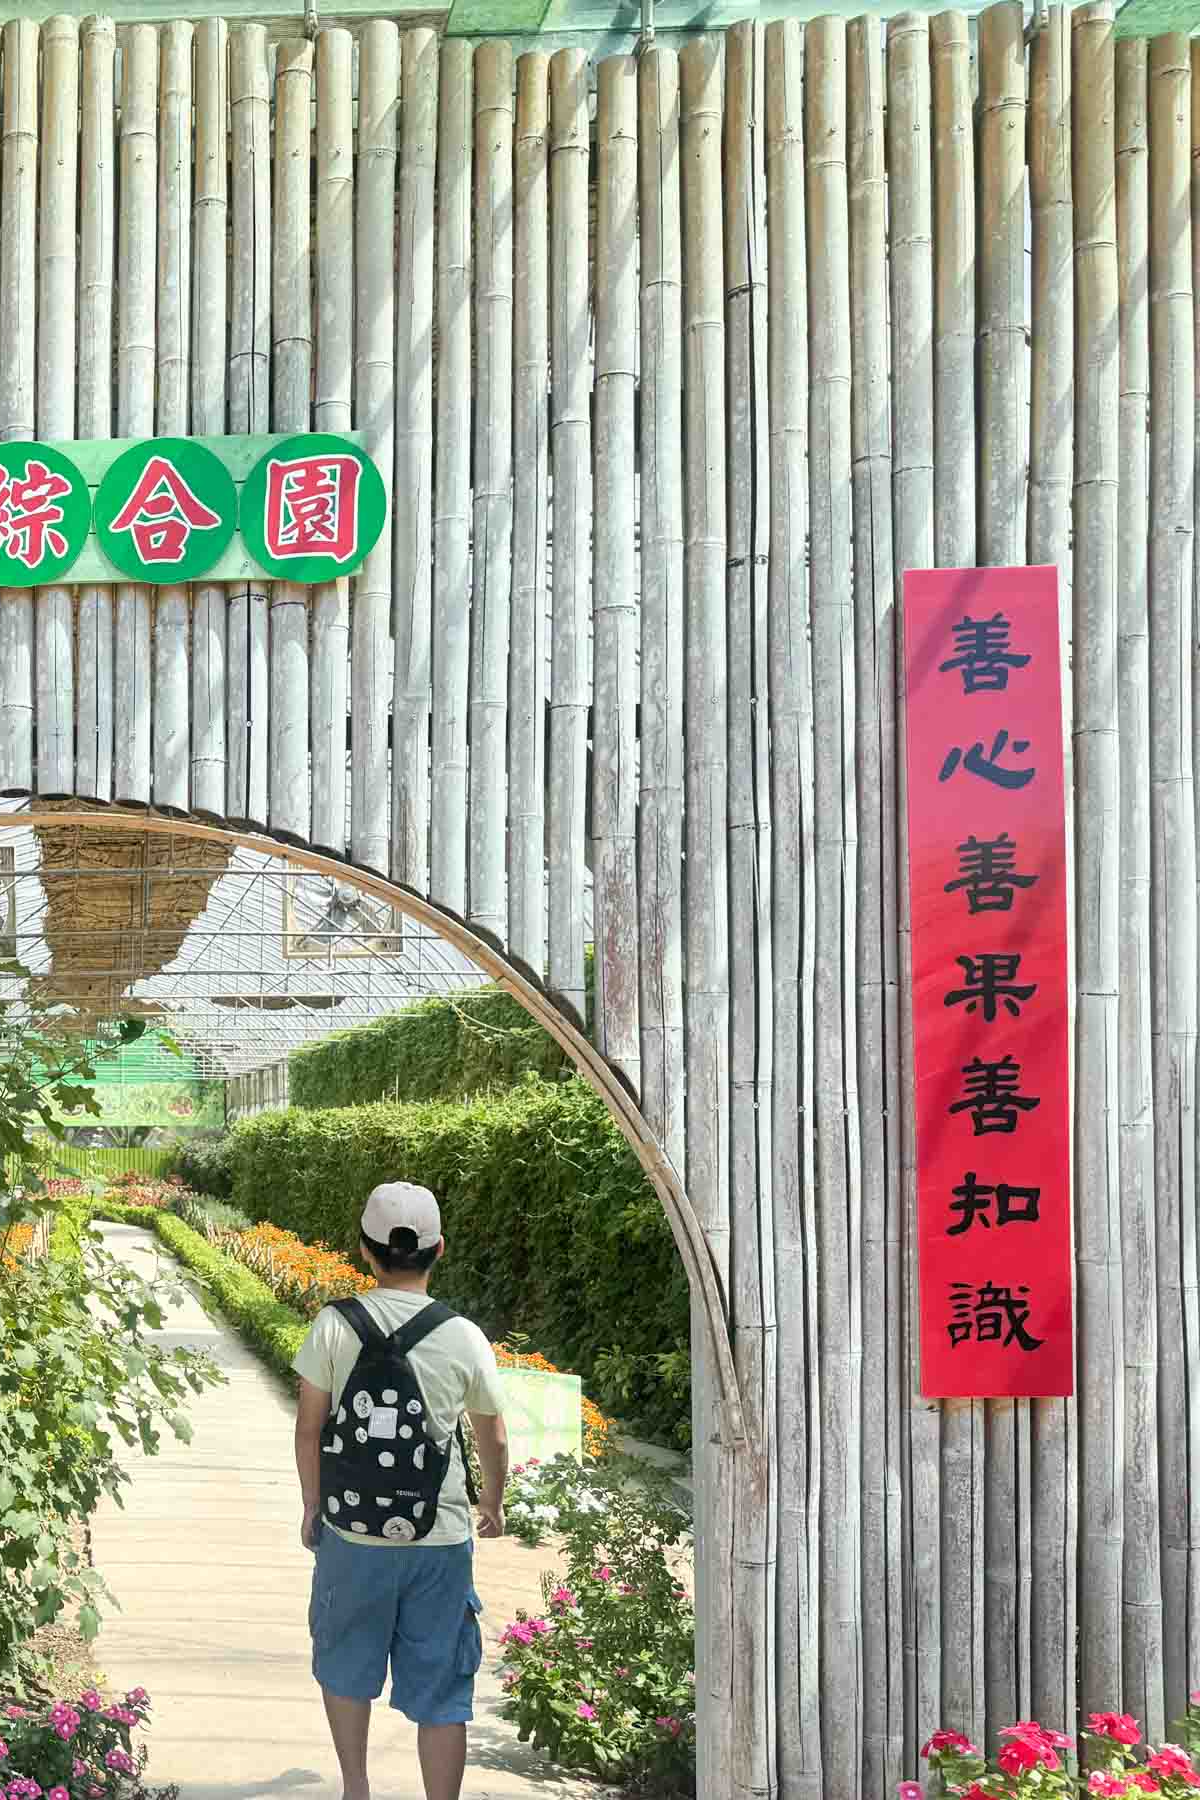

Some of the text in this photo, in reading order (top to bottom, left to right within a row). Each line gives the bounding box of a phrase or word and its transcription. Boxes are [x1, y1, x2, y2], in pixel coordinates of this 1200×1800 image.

[937, 612, 1046, 1353] 善心善果善知識
